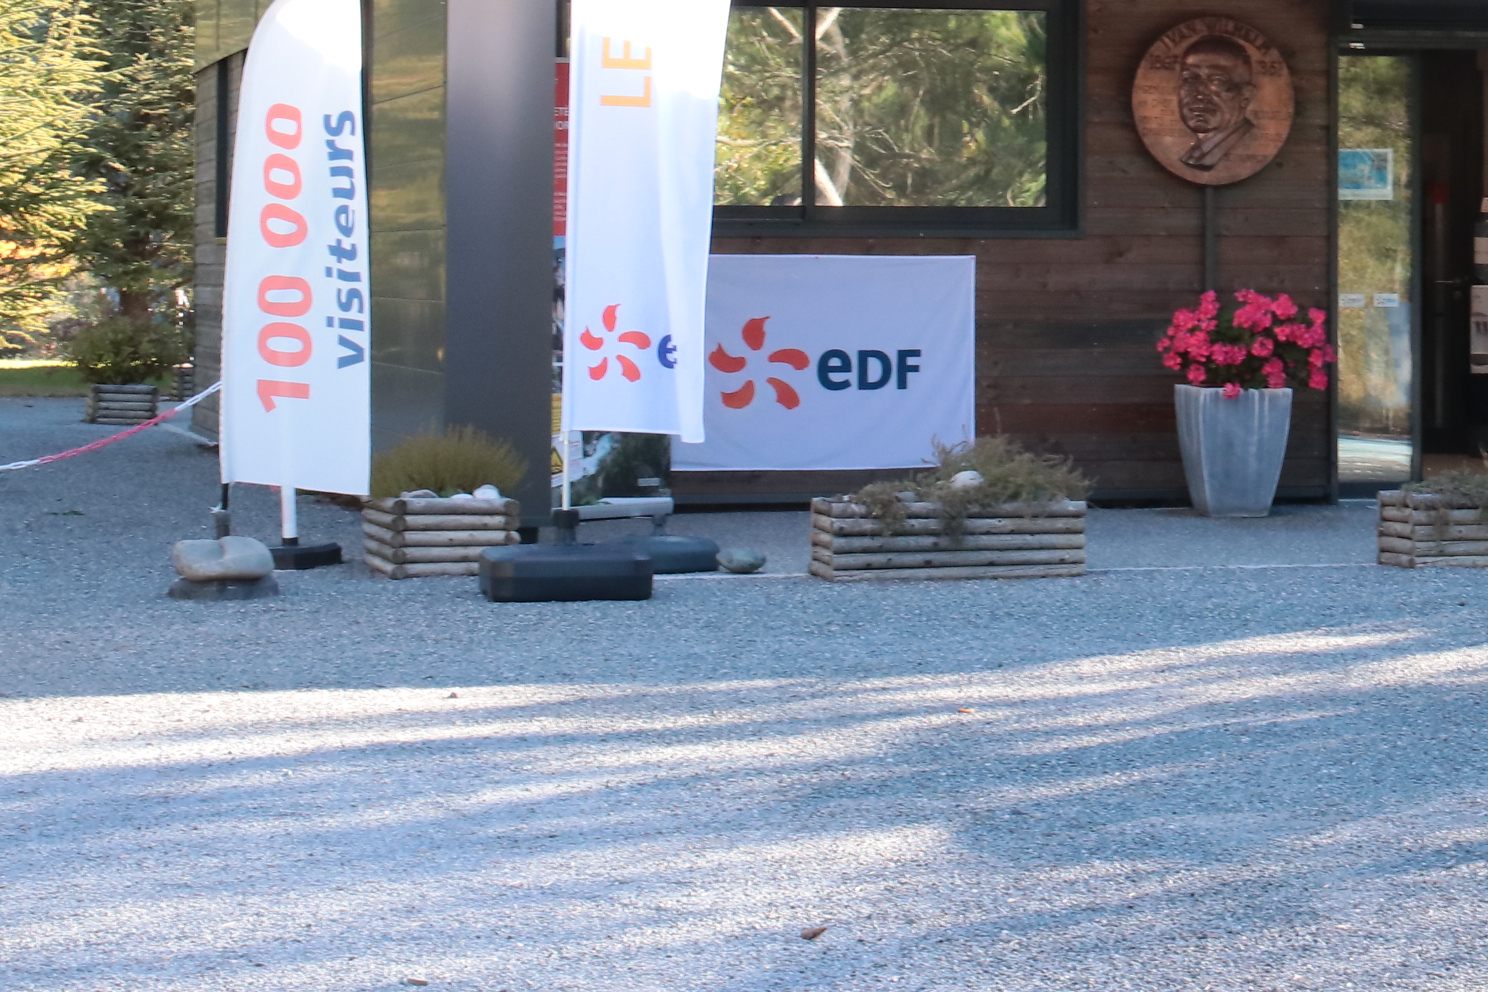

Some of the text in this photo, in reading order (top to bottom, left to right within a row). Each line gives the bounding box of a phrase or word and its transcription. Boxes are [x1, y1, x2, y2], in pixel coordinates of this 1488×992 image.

[256, 102, 313, 413] 100 000
[323, 109, 366, 370] visiteurs
